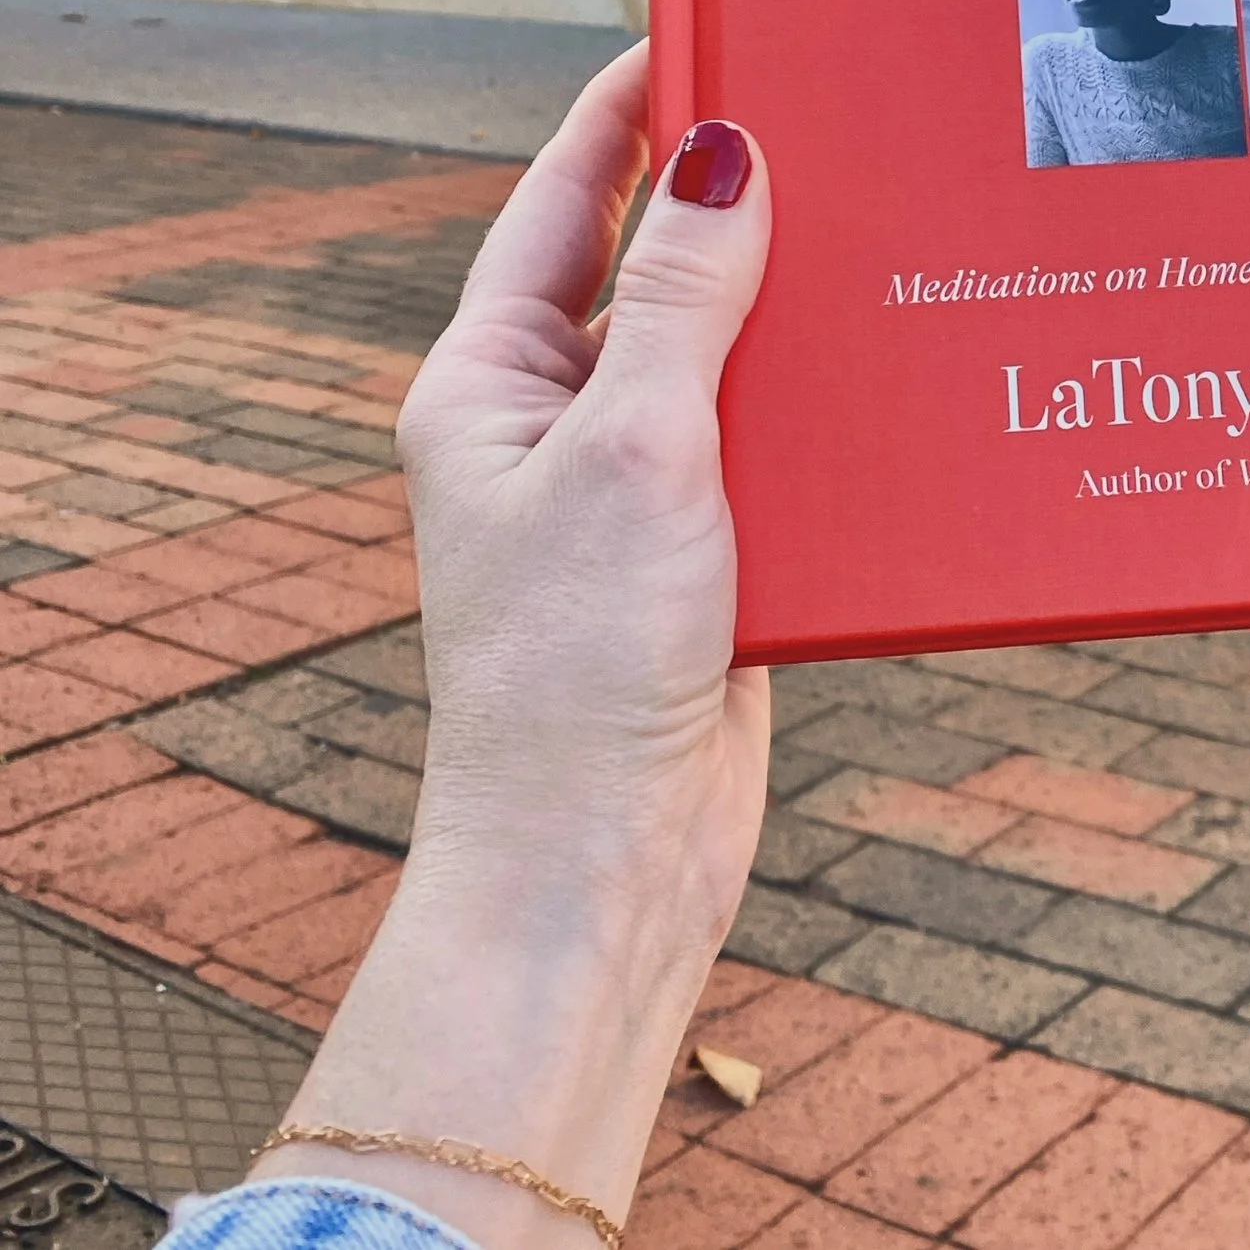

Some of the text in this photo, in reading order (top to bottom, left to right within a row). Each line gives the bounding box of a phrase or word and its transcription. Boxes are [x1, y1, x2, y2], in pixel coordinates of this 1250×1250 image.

[883, 264, 1097, 306] Meditations
[1105, 267, 1147, 292] on
[1075, 465, 1188, 498] Author
[1195, 458, 1232, 489] of
